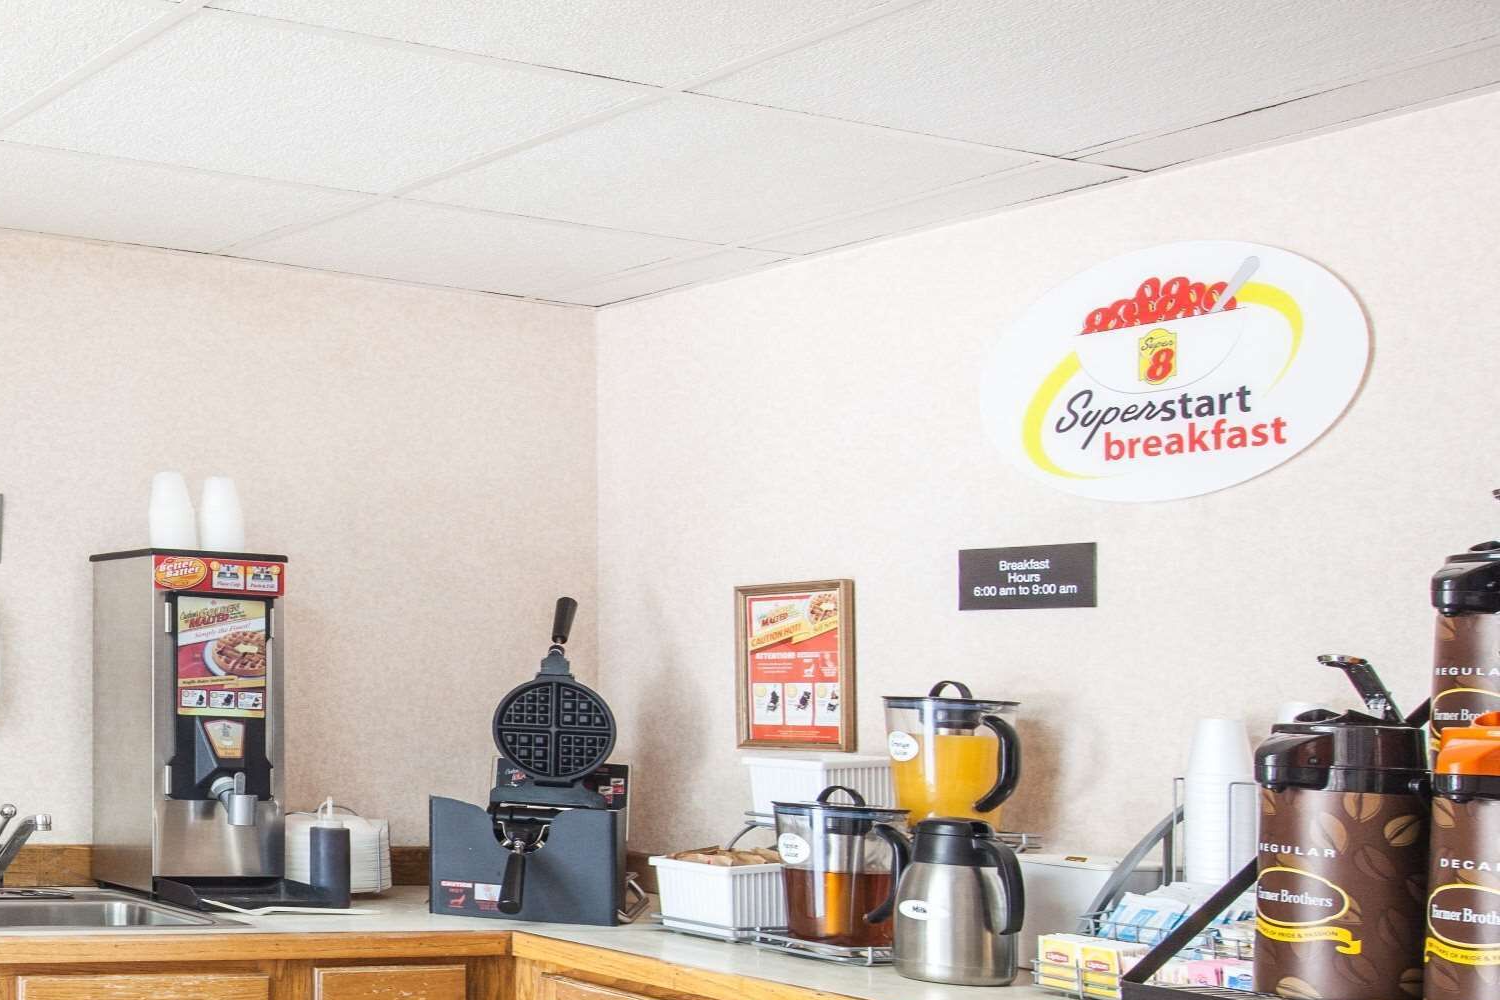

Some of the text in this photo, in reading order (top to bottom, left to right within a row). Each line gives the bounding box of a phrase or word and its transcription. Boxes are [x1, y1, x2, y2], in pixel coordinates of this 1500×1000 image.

[1140, 337, 1174, 355] Super
[1145, 347, 1175, 382] 8
[1104, 416, 1288, 461] breakfast
[999, 559, 1050, 571] Breakfast
[1007, 573, 1041, 583] Hours
[973, 584, 1078, 596] 6:00 am to 9:00 am
[1435, 666, 1500, 676] REGULA
[1280, 889, 1333, 908] Brothers
[1462, 908, 1500, 926] Broth
